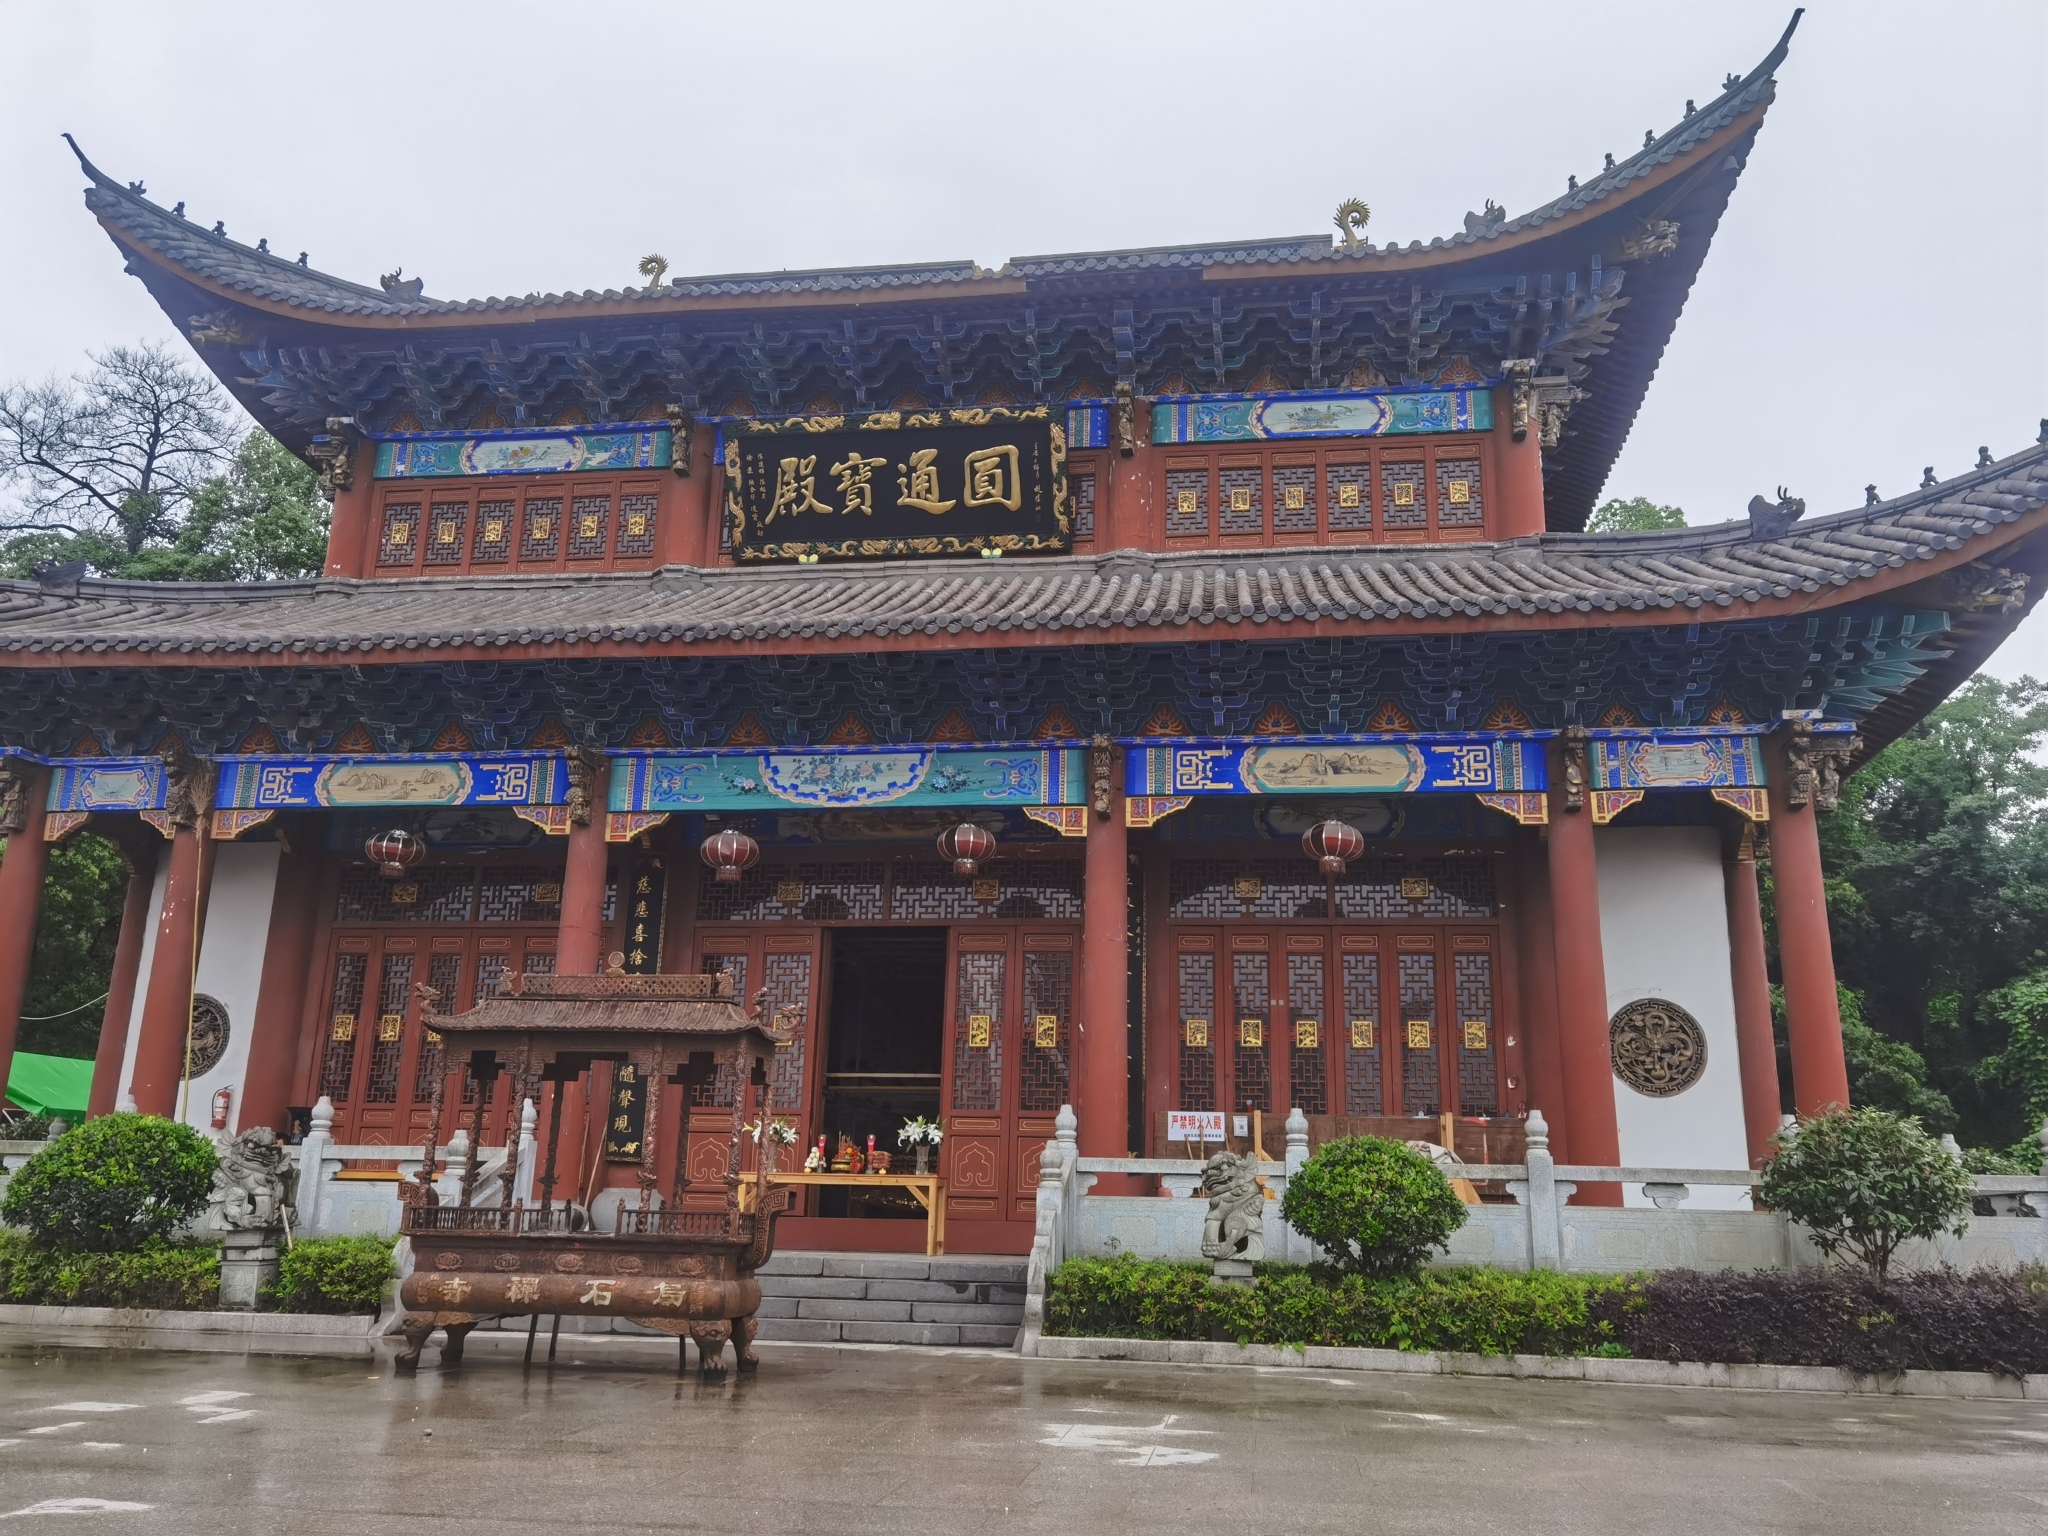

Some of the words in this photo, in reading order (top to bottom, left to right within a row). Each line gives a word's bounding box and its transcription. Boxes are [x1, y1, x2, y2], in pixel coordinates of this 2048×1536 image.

[765, 444, 1022, 526] 圓通寶殿
[629, 875, 653, 966] 慈悲喜捨
[1171, 1115, 1222, 1130] 严禁明火入殿
